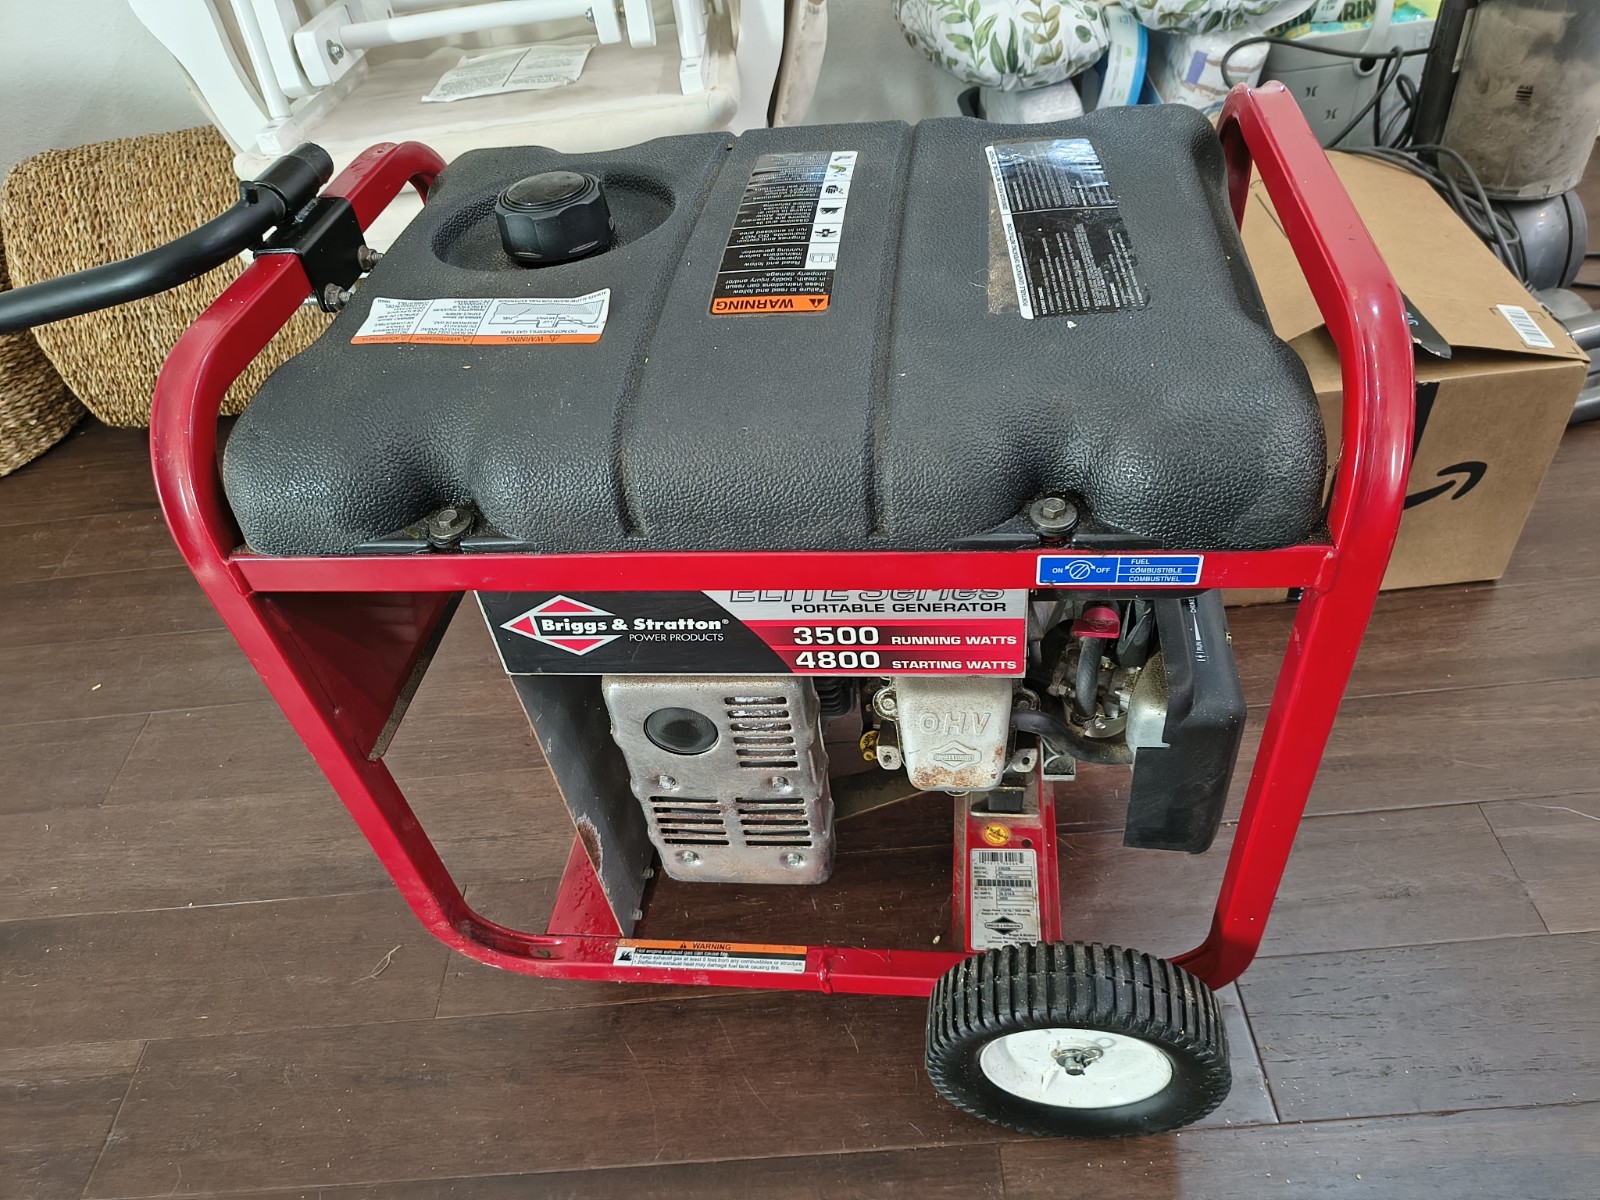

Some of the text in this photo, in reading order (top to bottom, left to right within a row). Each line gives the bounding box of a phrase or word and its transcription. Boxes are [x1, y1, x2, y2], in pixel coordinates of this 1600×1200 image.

[1014, 264, 1026, 286] GENERATOR
[1018, 285, 1029, 307] PORTABLE
[715, 299, 795, 311] WARNING
[505, 335, 544, 343] WARNING
[791, 602, 1006, 613] PORTABLE GENERATOR
[541, 618, 607, 634] Briggs
[611, 618, 629, 631] &
[629, 633, 724, 642] POWER PRODUCTS
[793, 626, 1017, 645] 3500 RUNNING WATTS
[1195, 641, 1203, 652] RUN
[795, 651, 1017, 669] 4800 STARTING WATTS
[919, 711, 991, 735] OHV
[692, 943, 732, 951] WARNING
